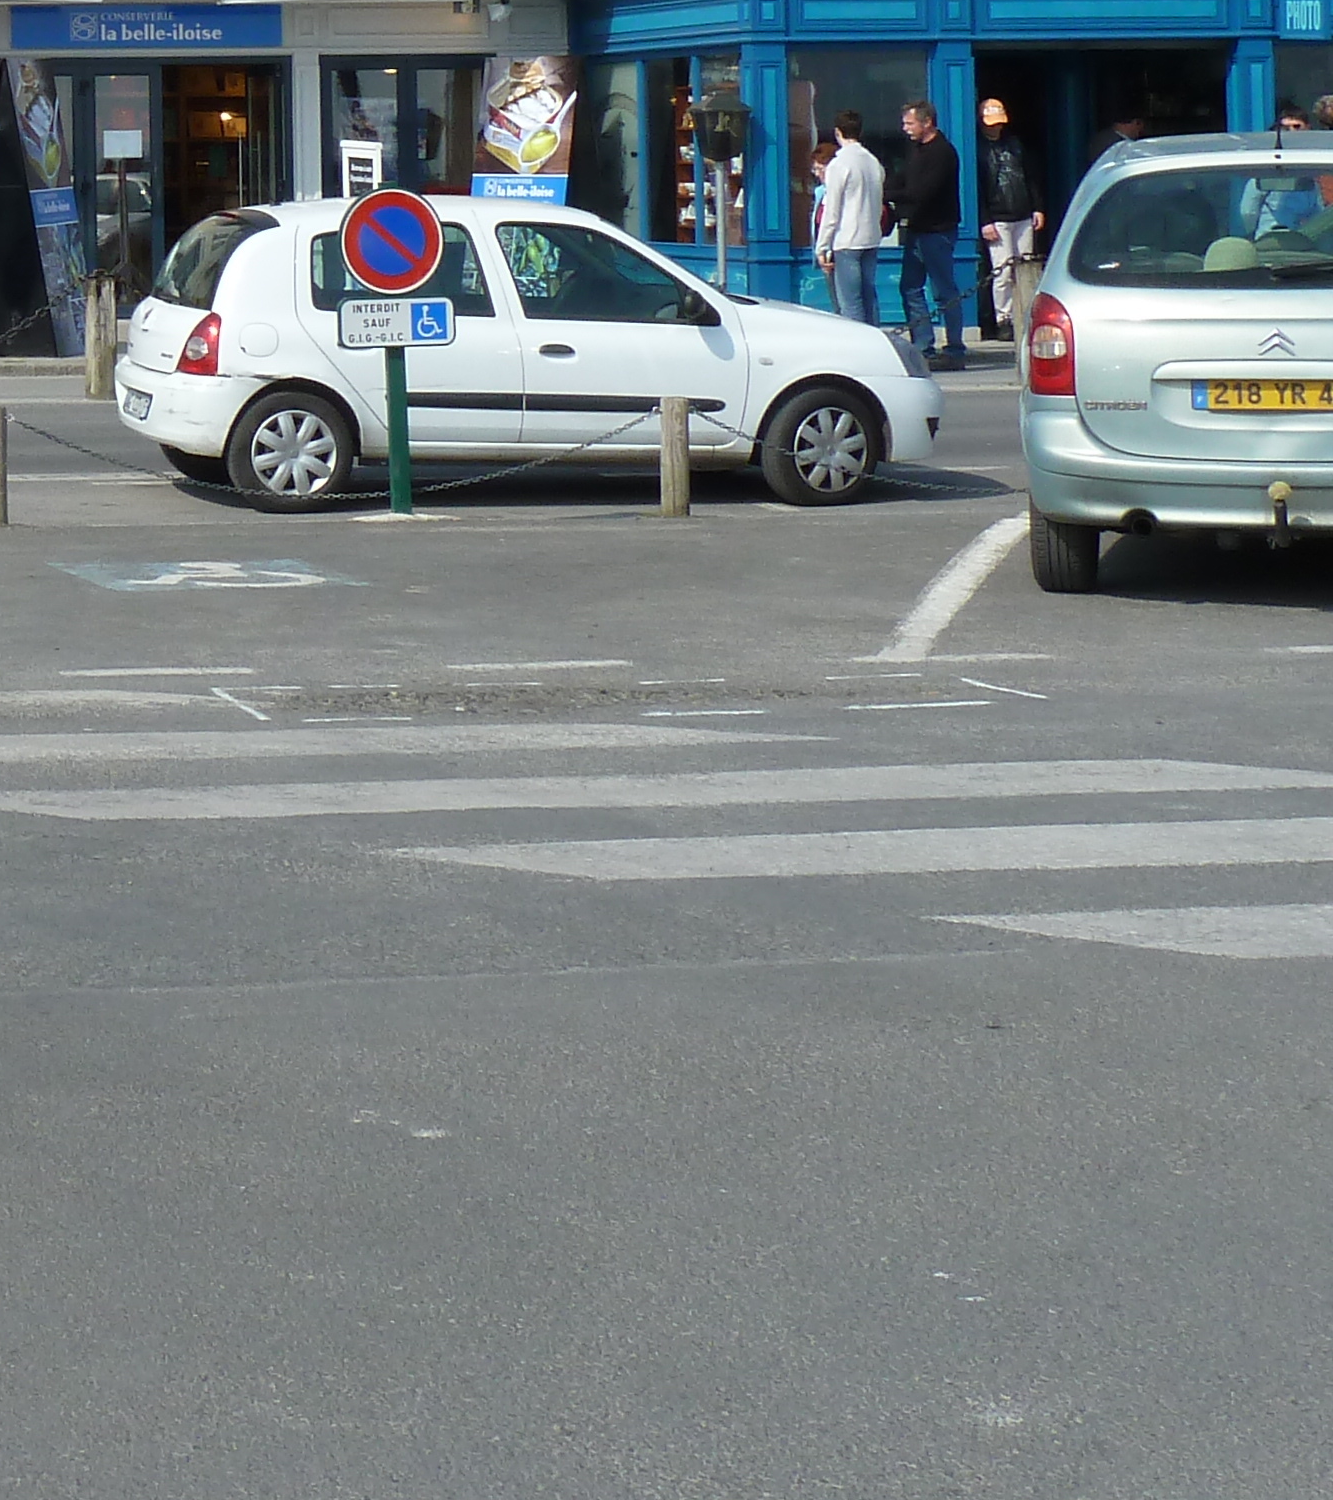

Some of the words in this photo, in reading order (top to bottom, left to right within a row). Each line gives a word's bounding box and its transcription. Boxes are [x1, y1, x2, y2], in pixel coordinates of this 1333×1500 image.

[100, 12, 174, 21] CONSERVERIE
[1286, 0, 1321, 32] PHOTO
[100, 23, 117, 41] la
[121, 23, 222, 41] belle-iloise
[352, 302, 400, 314] INTERDIT
[363, 318, 391, 328] SAUF
[1214, 382, 1262, 405] 218
[1274, 381, 1306, 405] YR
